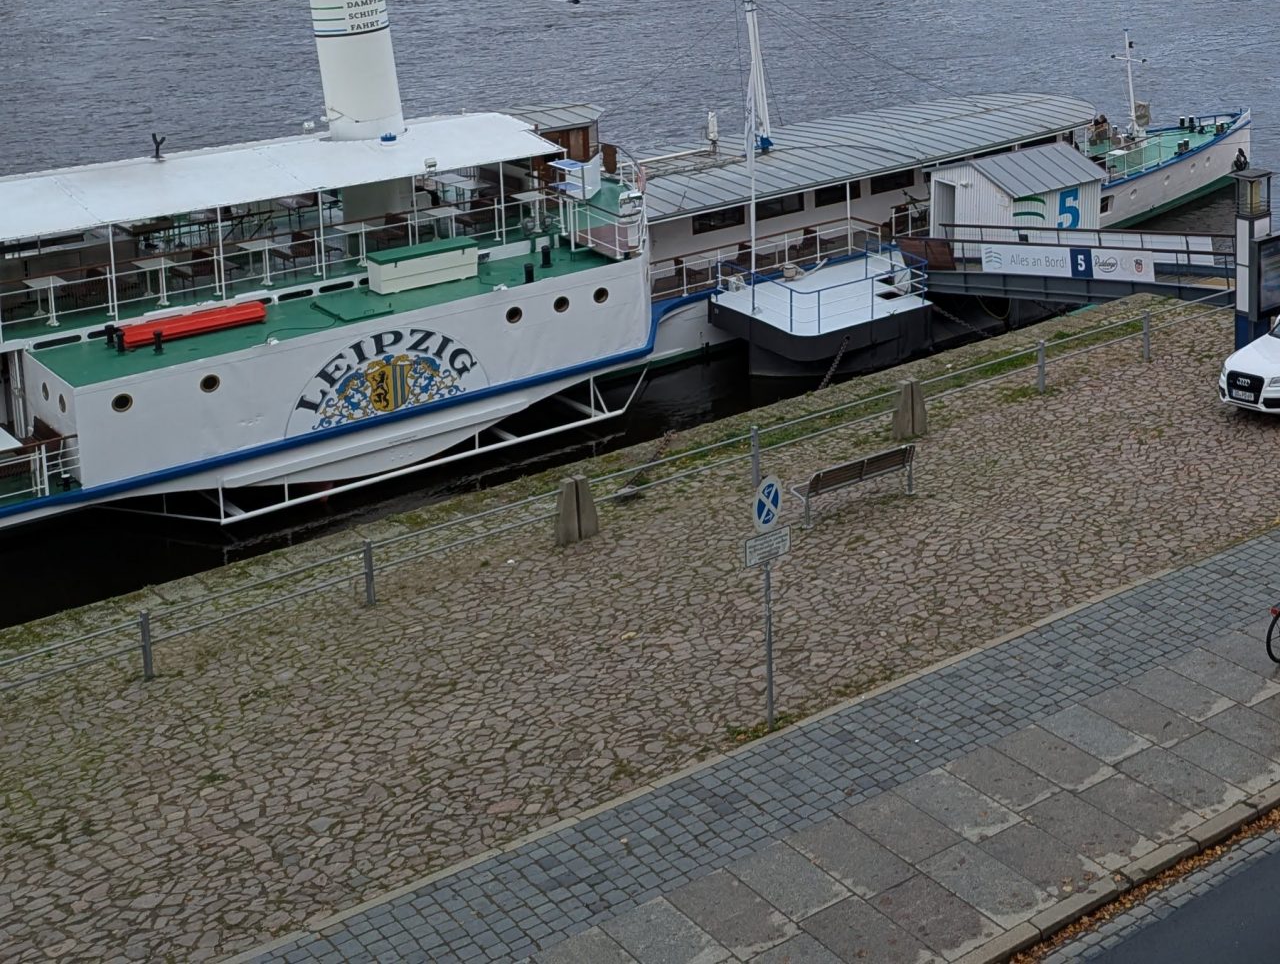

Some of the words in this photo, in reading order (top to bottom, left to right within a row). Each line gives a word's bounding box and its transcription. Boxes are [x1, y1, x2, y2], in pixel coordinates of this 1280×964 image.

[348, 9, 379, 20] SCHIFF
[351, 20, 380, 31] FAHRT
[1057, 187, 1080, 230] 5
[1010, 254, 1029, 267] Alles
[1031, 257, 1042, 267] an
[1044, 255, 1067, 269] Bord!
[1077, 254, 1086, 271] 5
[295, 328, 478, 414] LEIPZIG
